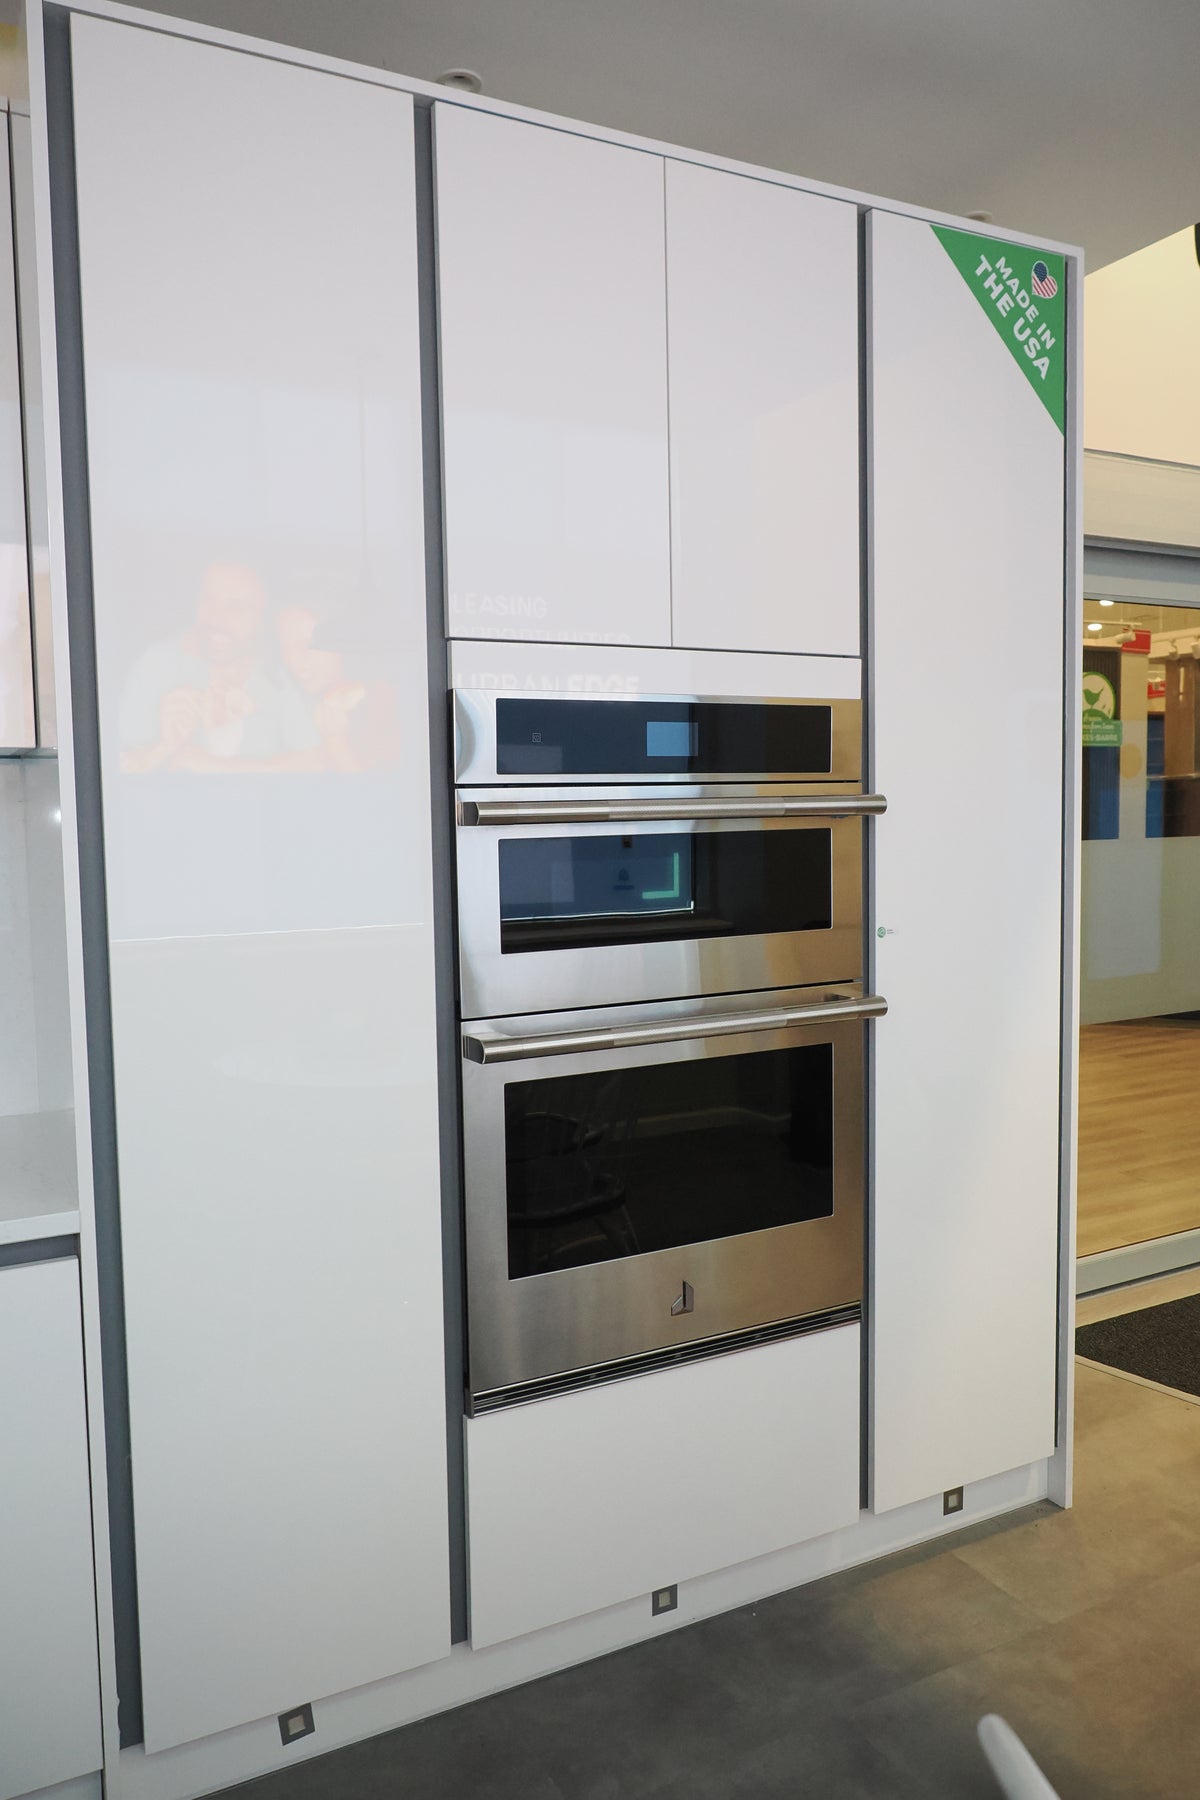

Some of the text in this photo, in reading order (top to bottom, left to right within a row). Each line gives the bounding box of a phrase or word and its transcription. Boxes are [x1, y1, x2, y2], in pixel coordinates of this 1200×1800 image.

[975, 254, 1050, 380] THE USA
[995, 256, 1056, 350] MADE IN
[453, 592, 548, 619] LEASING
